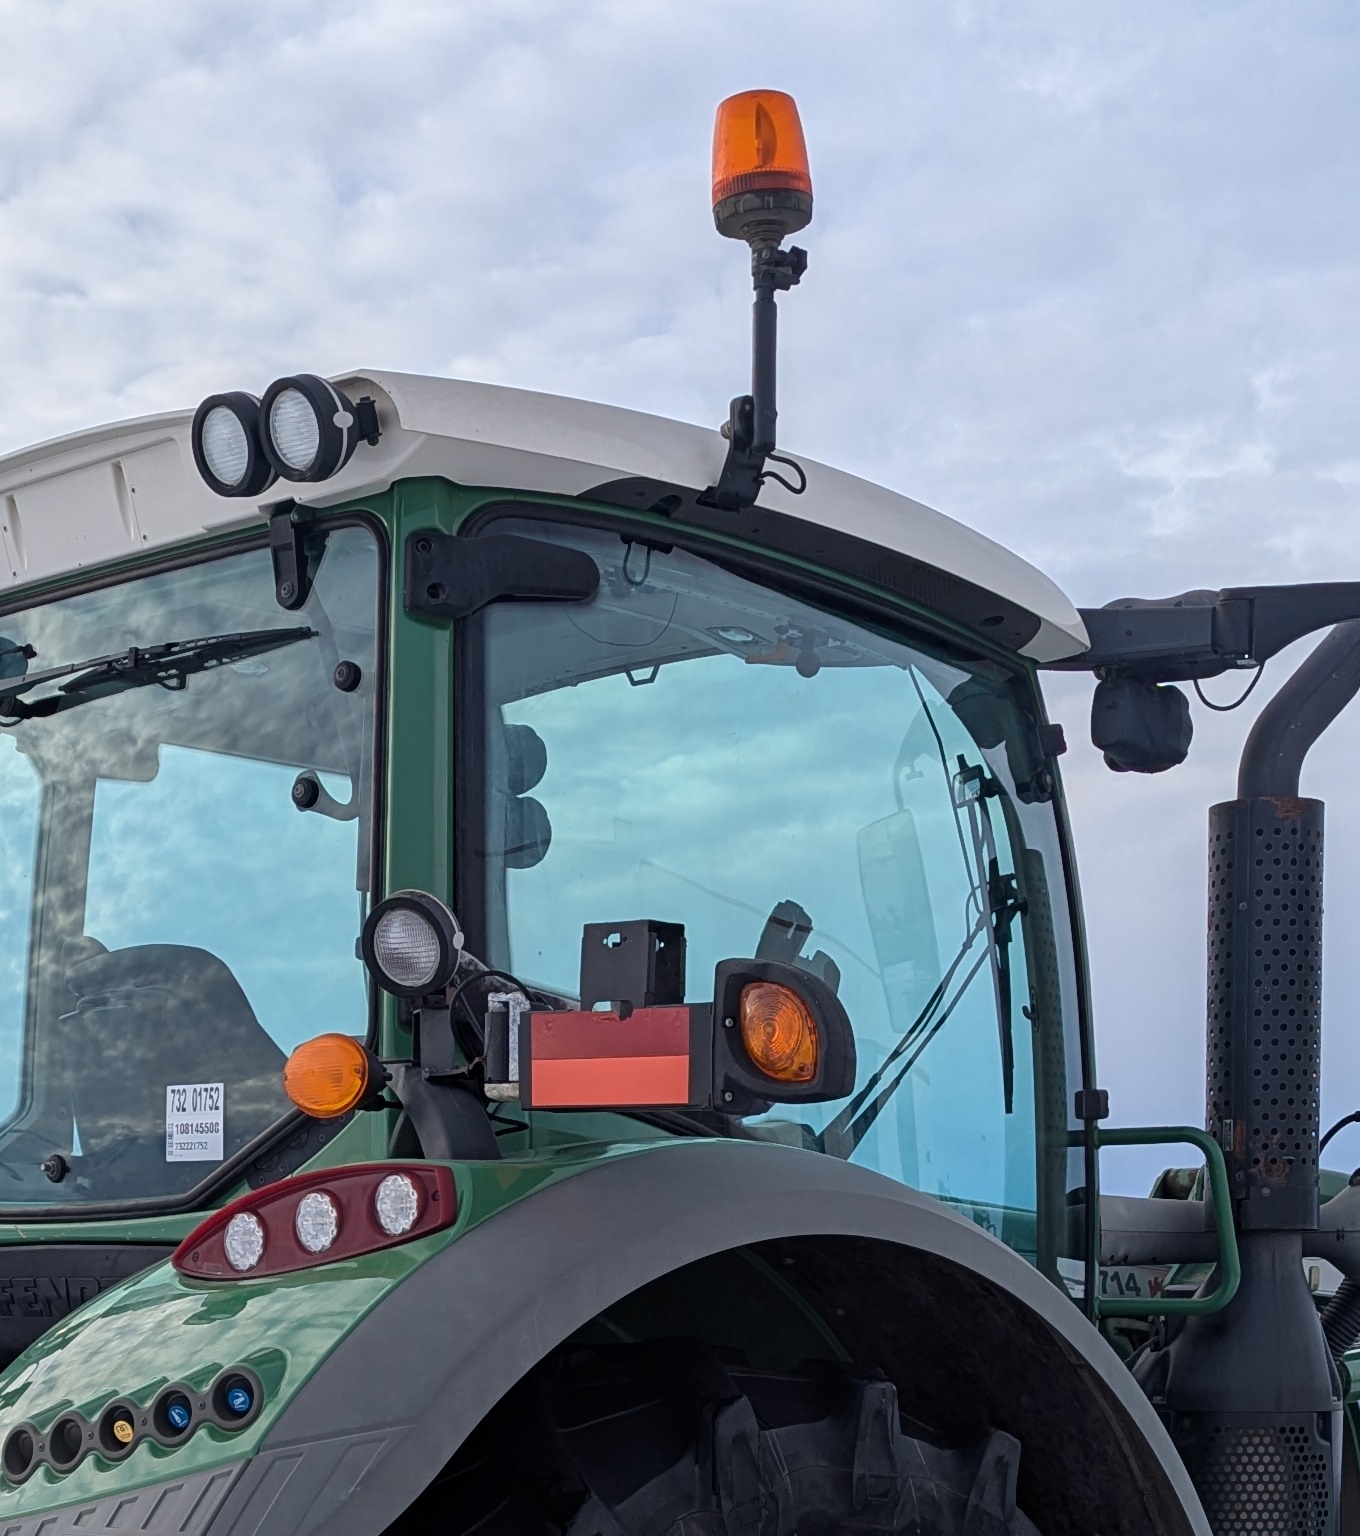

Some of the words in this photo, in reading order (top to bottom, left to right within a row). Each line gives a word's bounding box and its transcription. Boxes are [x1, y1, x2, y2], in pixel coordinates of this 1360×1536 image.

[171, 1088, 186, 1112] 732
[192, 1086, 220, 1112] 01752
[1100, 1270, 1141, 1296] 714
